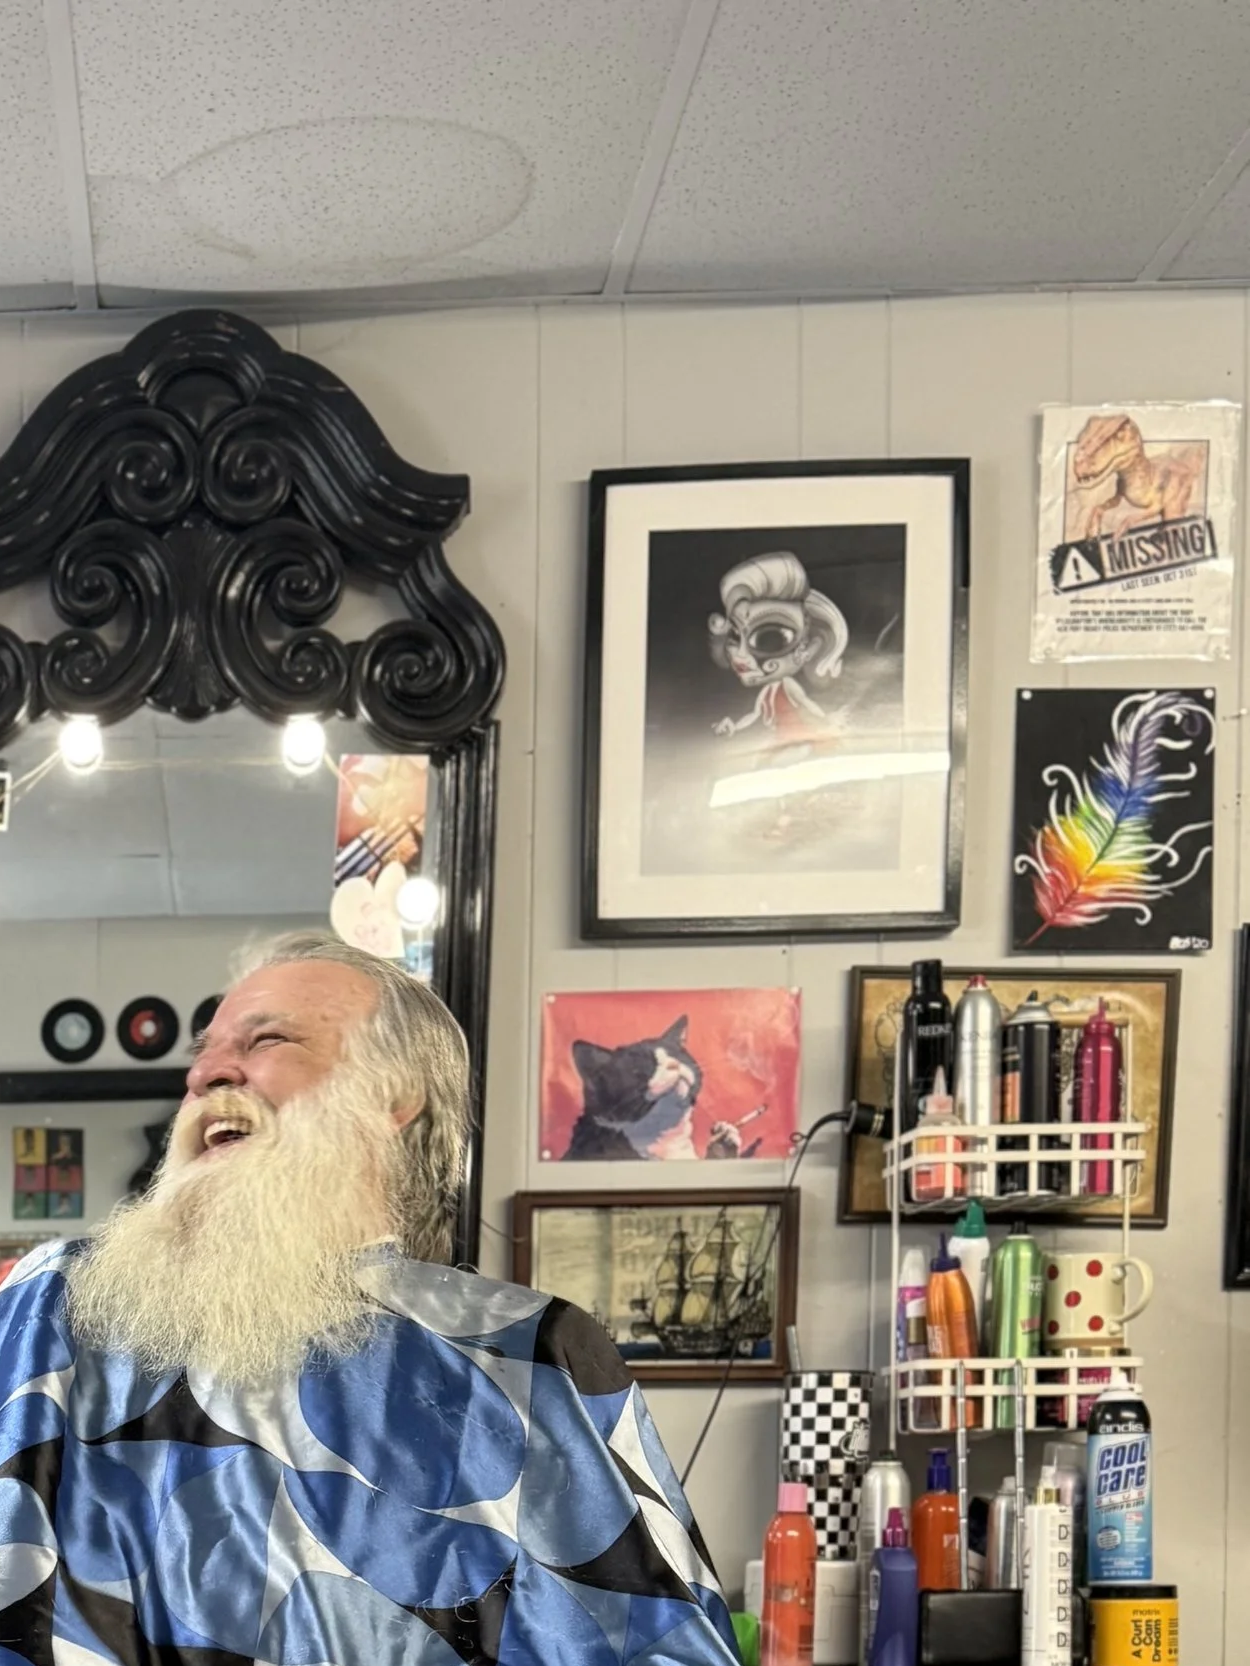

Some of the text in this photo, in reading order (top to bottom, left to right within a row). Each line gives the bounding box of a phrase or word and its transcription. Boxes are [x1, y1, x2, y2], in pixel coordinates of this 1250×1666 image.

[1107, 523, 1205, 574] MISSING
[1099, 1420, 1145, 1434] andis
[1099, 1439, 1147, 1472] COOL
[1131, 1618, 1143, 1659] A Curl
[1143, 1618, 1153, 1647] Can
[1152, 1618, 1162, 1662] Dream
